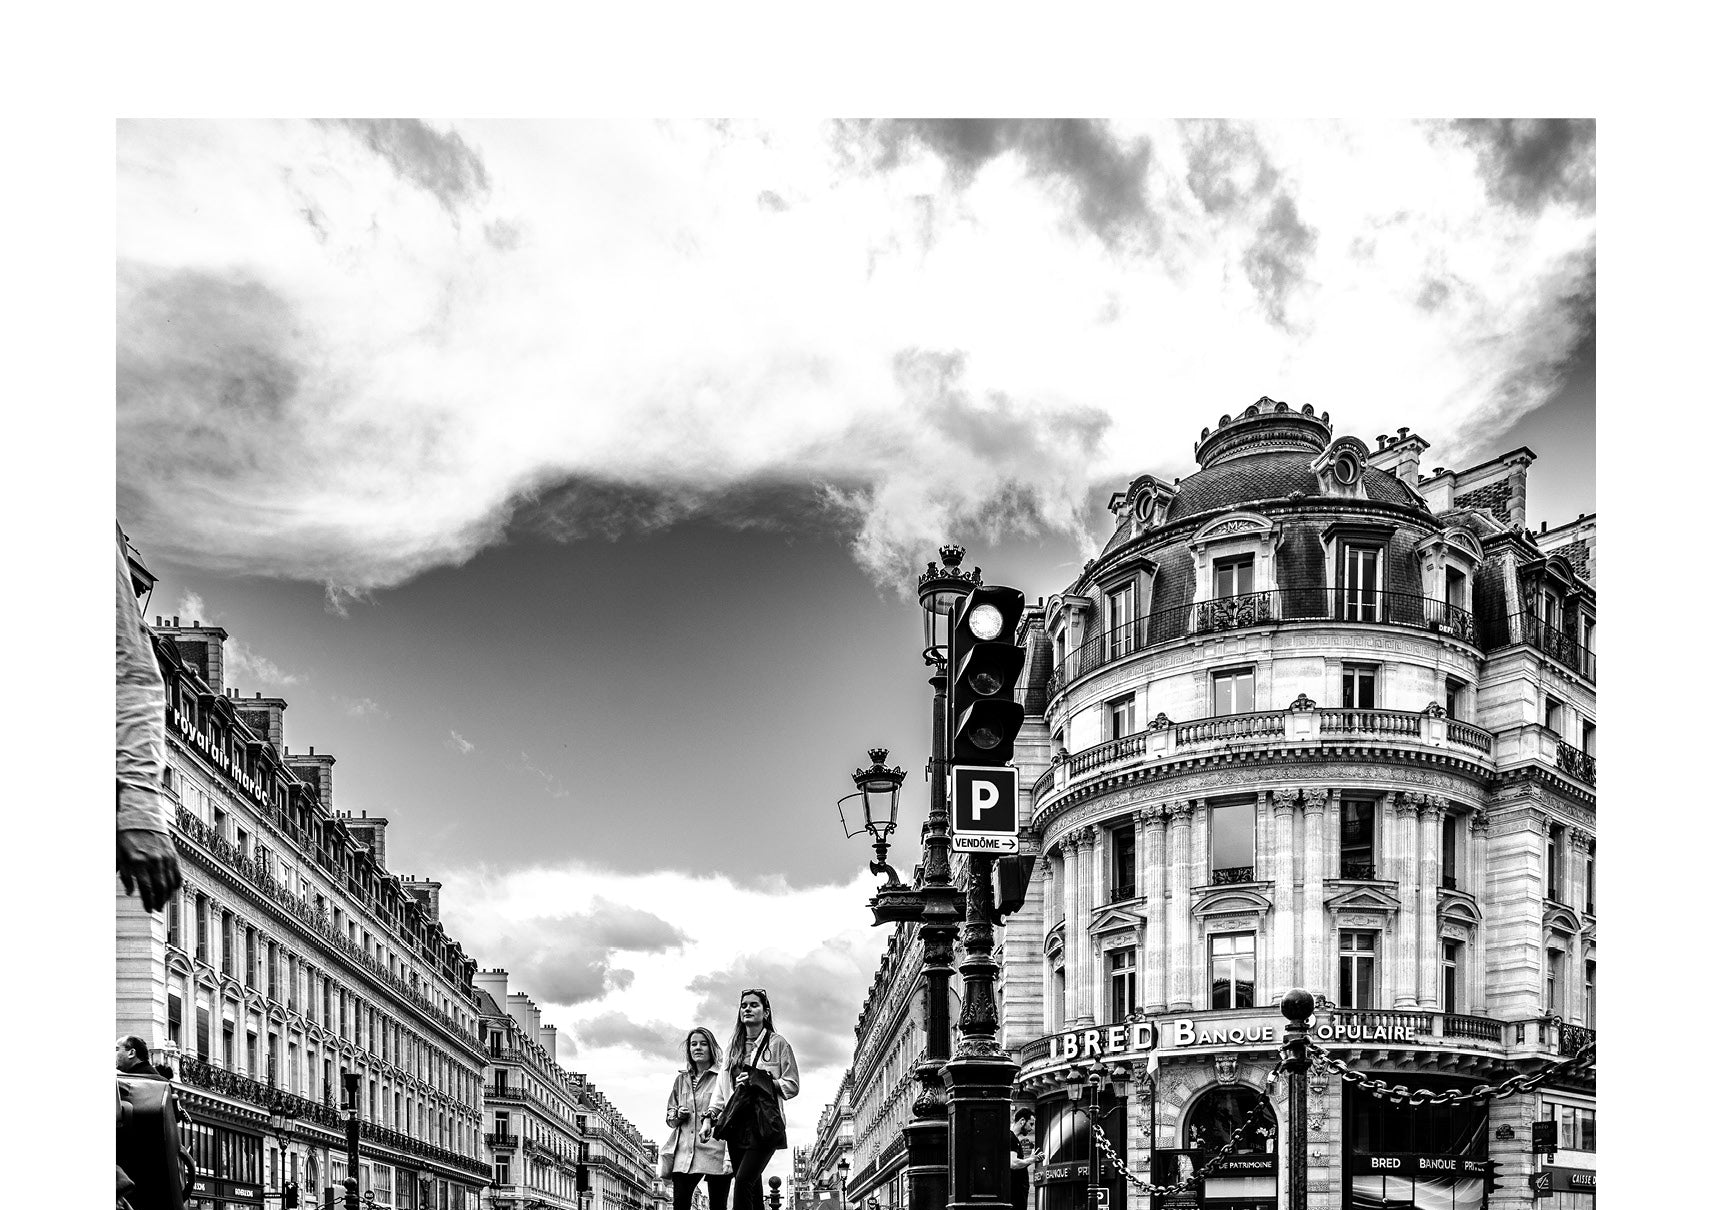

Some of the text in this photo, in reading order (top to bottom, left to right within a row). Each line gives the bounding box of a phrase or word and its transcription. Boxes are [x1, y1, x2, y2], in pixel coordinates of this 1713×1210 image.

[174, 708, 268, 806] royal air maroc
[972, 780, 1000, 821] P
[954, 836, 1000, 849] VENDÔME
[1173, 1018, 1274, 1046] BANQUE
[1304, 1013, 1416, 1041] OPULAIRE
[1229, 1161, 1273, 1169] PATRIMOINE
[1371, 1157, 1401, 1169] BRED
[1419, 1158, 1457, 1170] BANQUE
[1045, 1167, 1069, 1179] BANQUE
[1572, 1174, 1591, 1185] CAISSE
